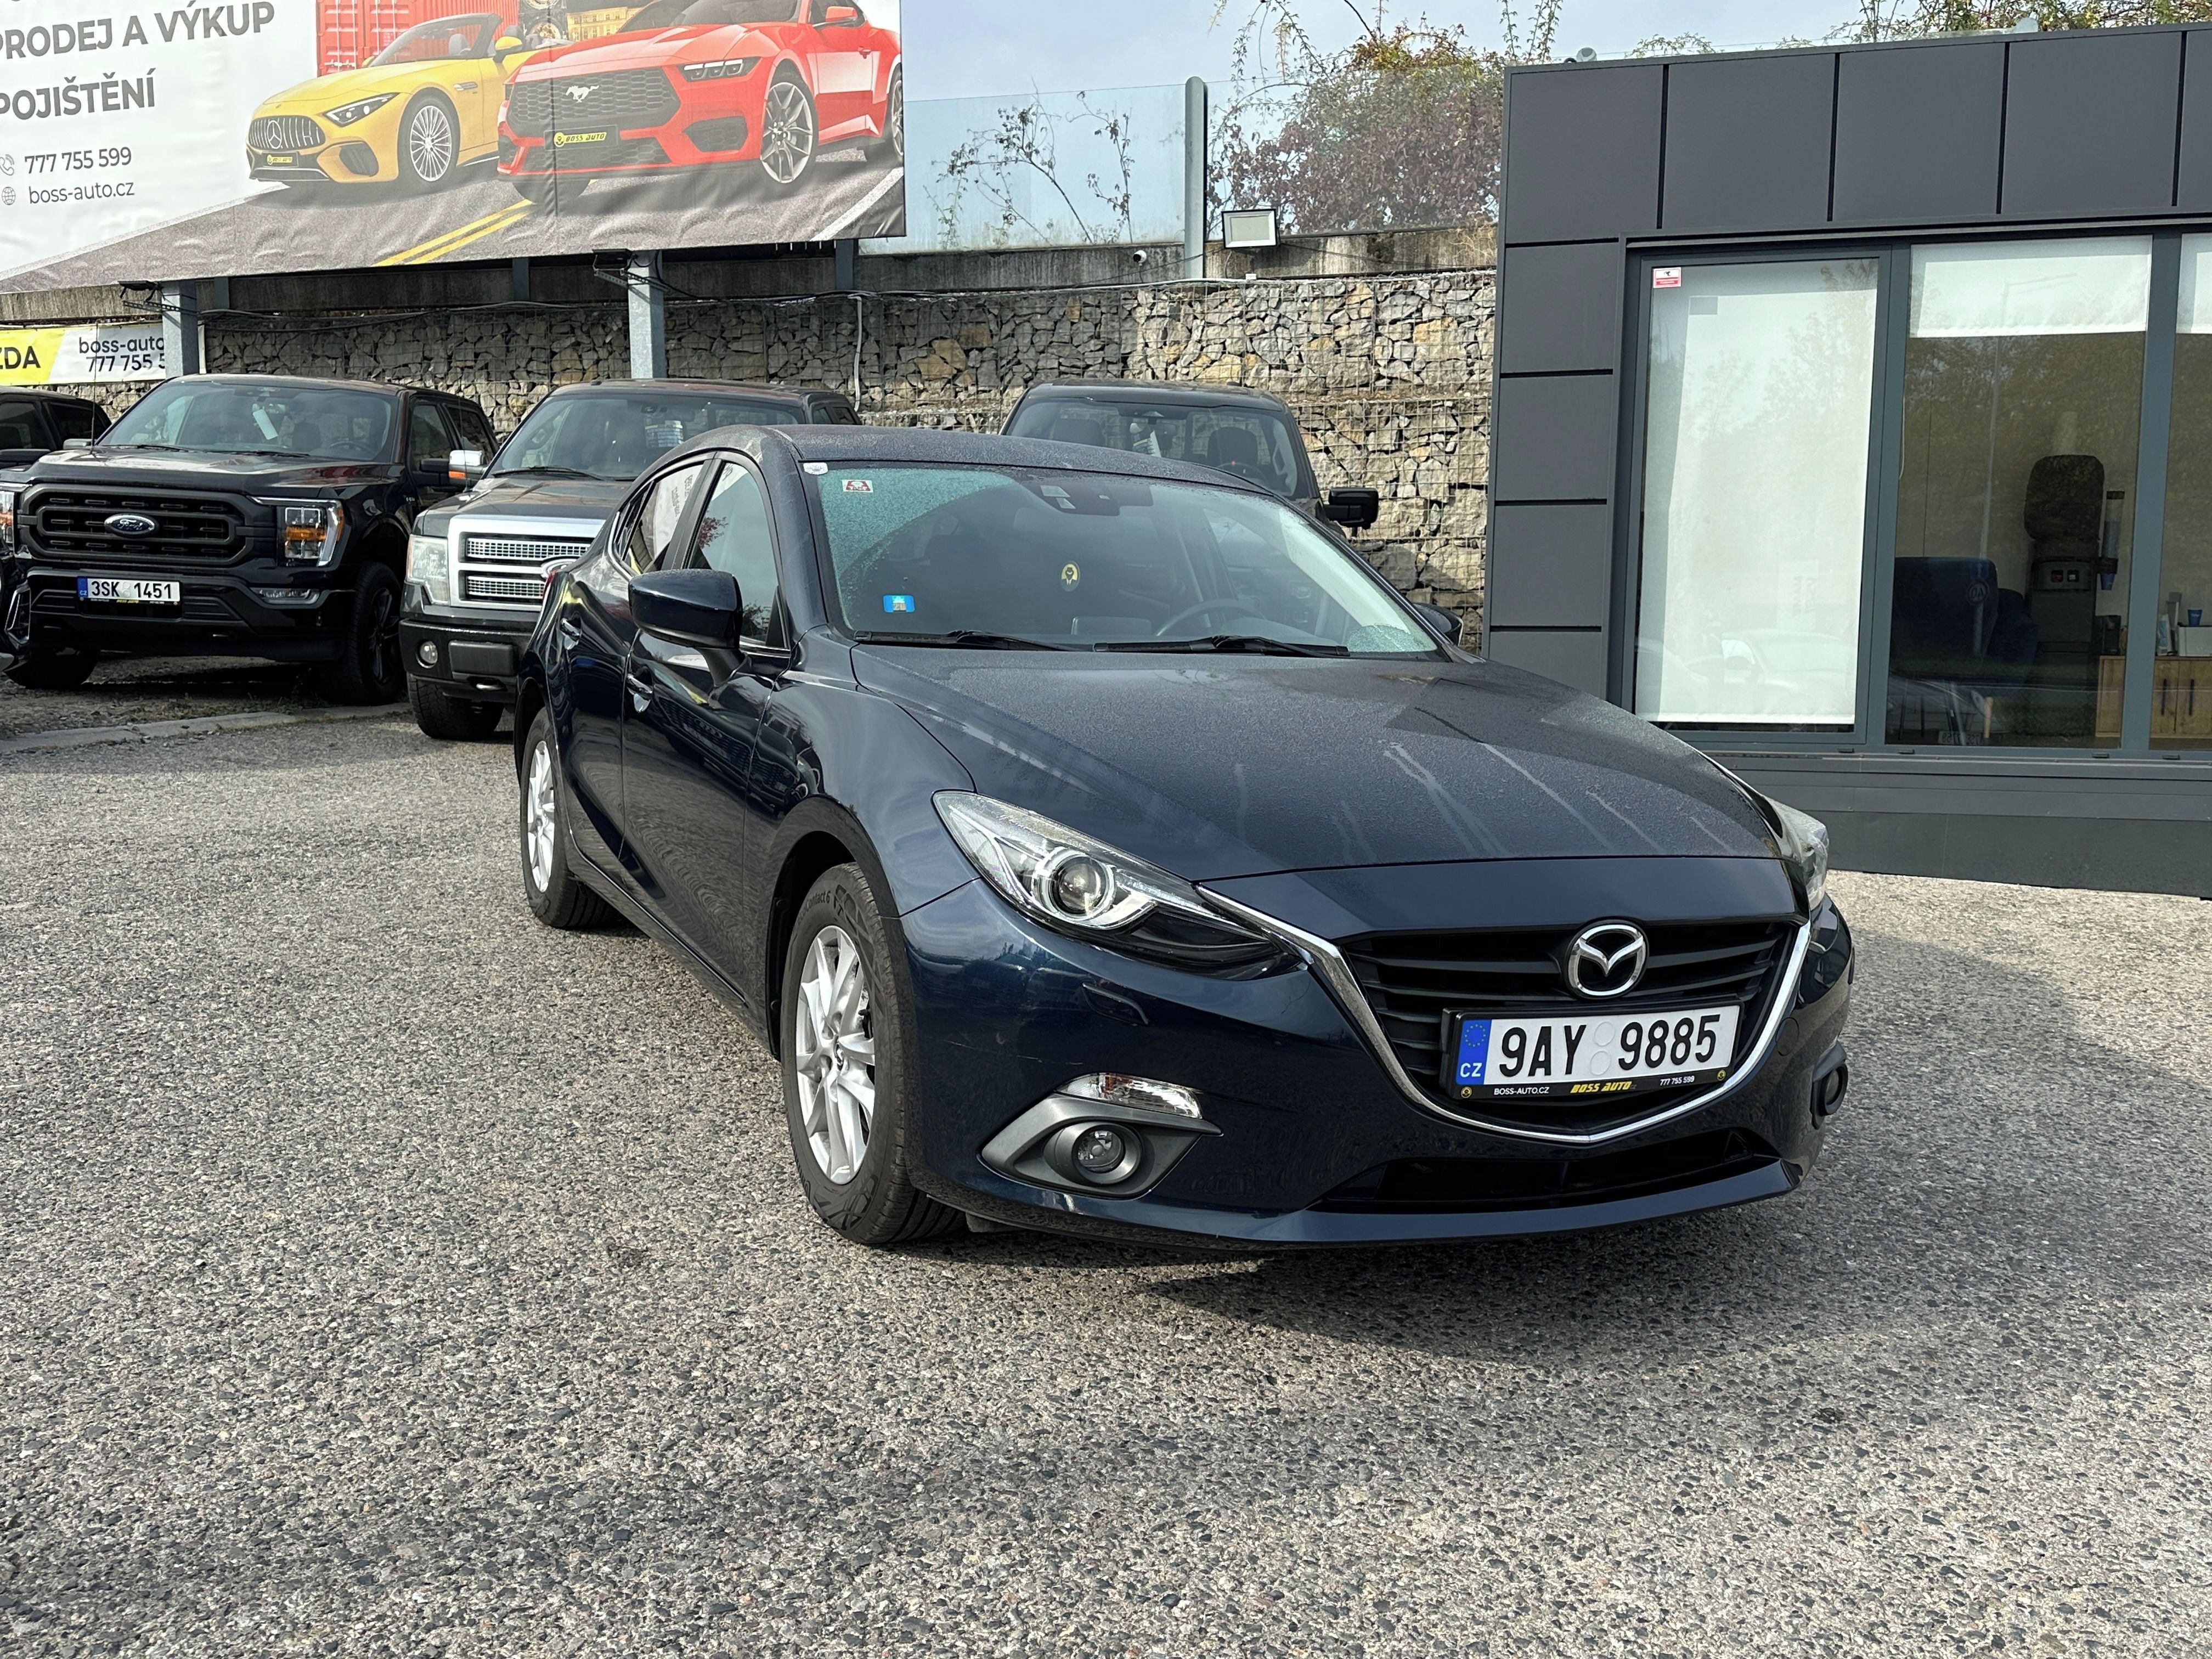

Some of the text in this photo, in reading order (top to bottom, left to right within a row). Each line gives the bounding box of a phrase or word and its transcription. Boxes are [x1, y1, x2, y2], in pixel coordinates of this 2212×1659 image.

[0, 0, 275, 59] RODEJ A VÝKUP
[24, 146, 132, 174] 777 755 599
[29, 181, 135, 205] boss-auto.cz
[0, 346, 41, 369] DA
[86, 356, 115, 373] 777
[120, 354, 153, 371] 755
[91, 580, 120, 597] 3SK
[134, 583, 172, 599] 1451
[1460, 1014, 1720, 1077] CZ 9AY 9885
[1494, 1086, 1550, 1095] BOSS-AUTO.CZ
[1570, 1082, 1600, 1094] BOSS
[1660, 1078, 1671, 1086] 777
[1671, 1076, 1683, 1085] 755
[1683, 1075, 1695, 1084] 599
